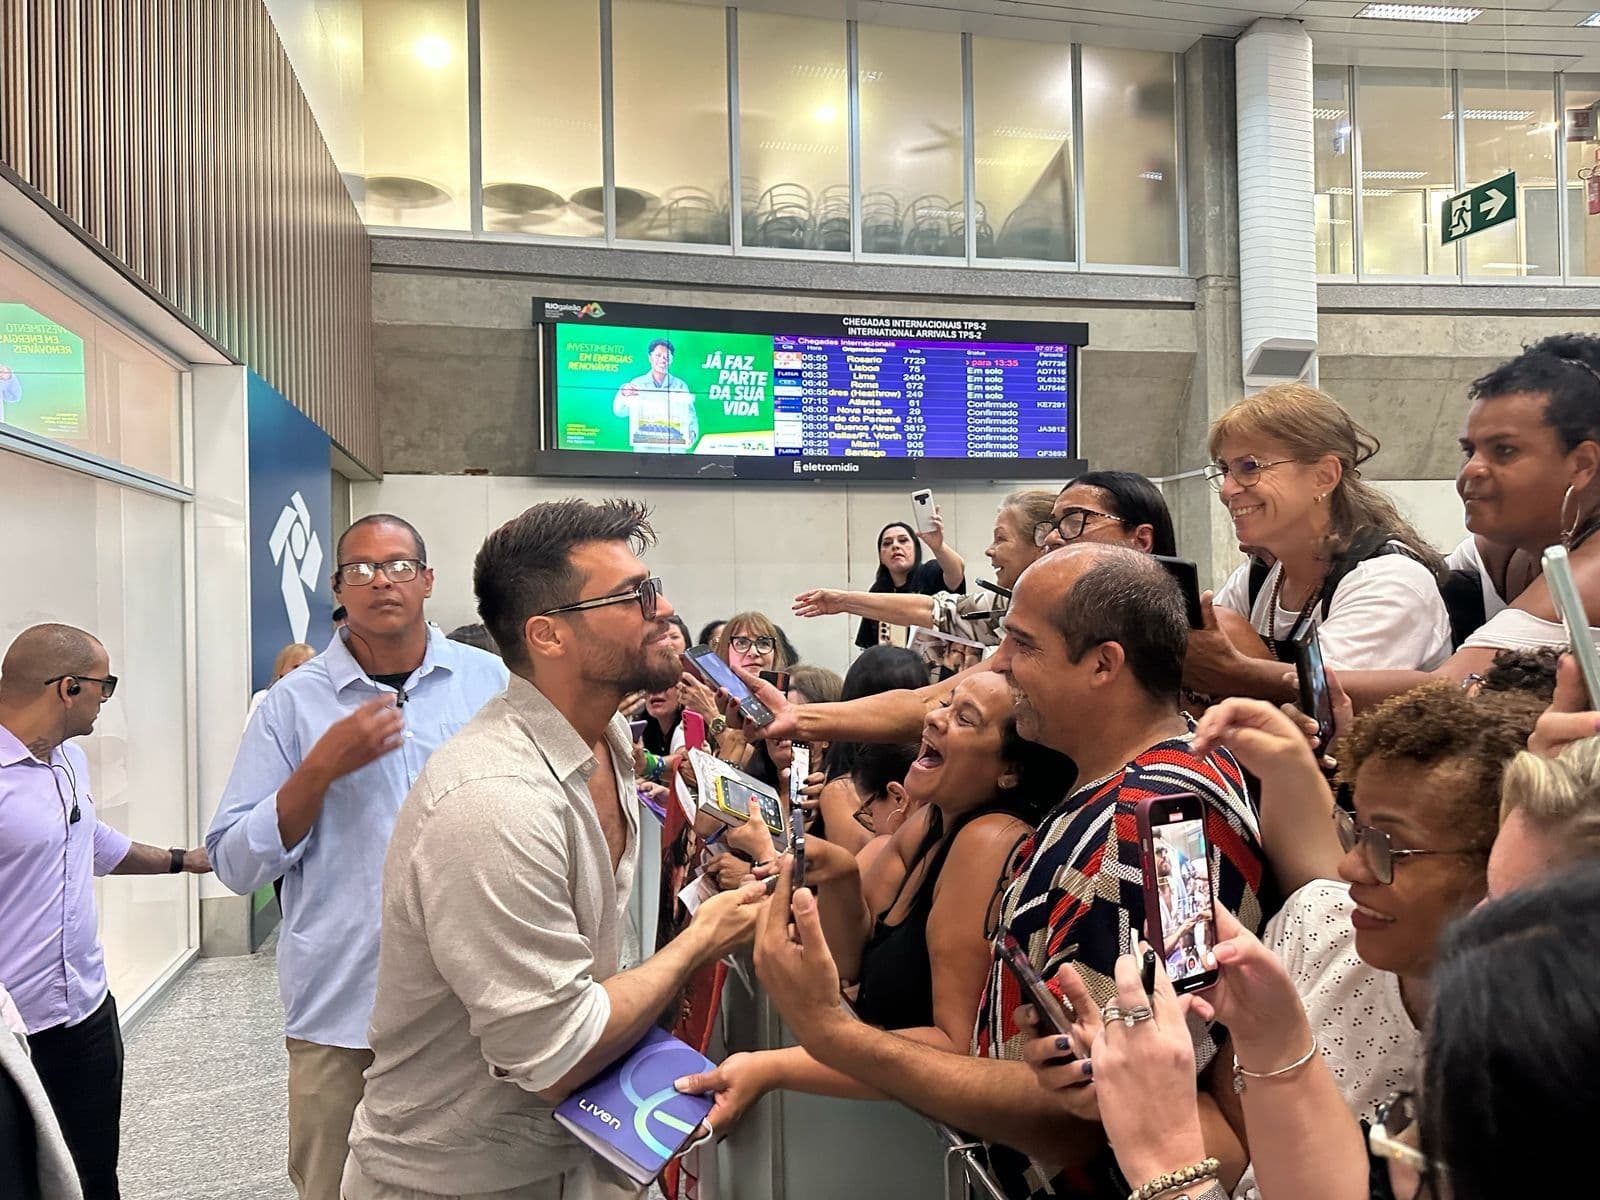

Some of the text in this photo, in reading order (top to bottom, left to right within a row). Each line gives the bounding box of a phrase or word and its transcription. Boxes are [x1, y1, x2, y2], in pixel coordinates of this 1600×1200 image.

[843, 317, 986, 330] CHEGADAS INTERNACIONAIS TPS-2
[848, 327, 982, 340] INTERNATIONAL ARRIVALS TPS-2
[566, 343, 624, 353] INVESTIMENTO
[798, 337, 896, 348] Chegadas Internacionais
[579, 352, 633, 364] EM ENERGIAS
[702, 350, 755, 370] JÁ FAZ
[846, 355, 882, 363] Rosario
[849, 364, 880, 372] Lisboa
[718, 370, 768, 386] PARTE
[850, 380, 879, 388] Roma
[708, 384, 765, 402] DA SUA
[723, 400, 760, 416] VIDA
[834, 424, 870, 432] Buenos
[802, 462, 859, 472] eletromidia
